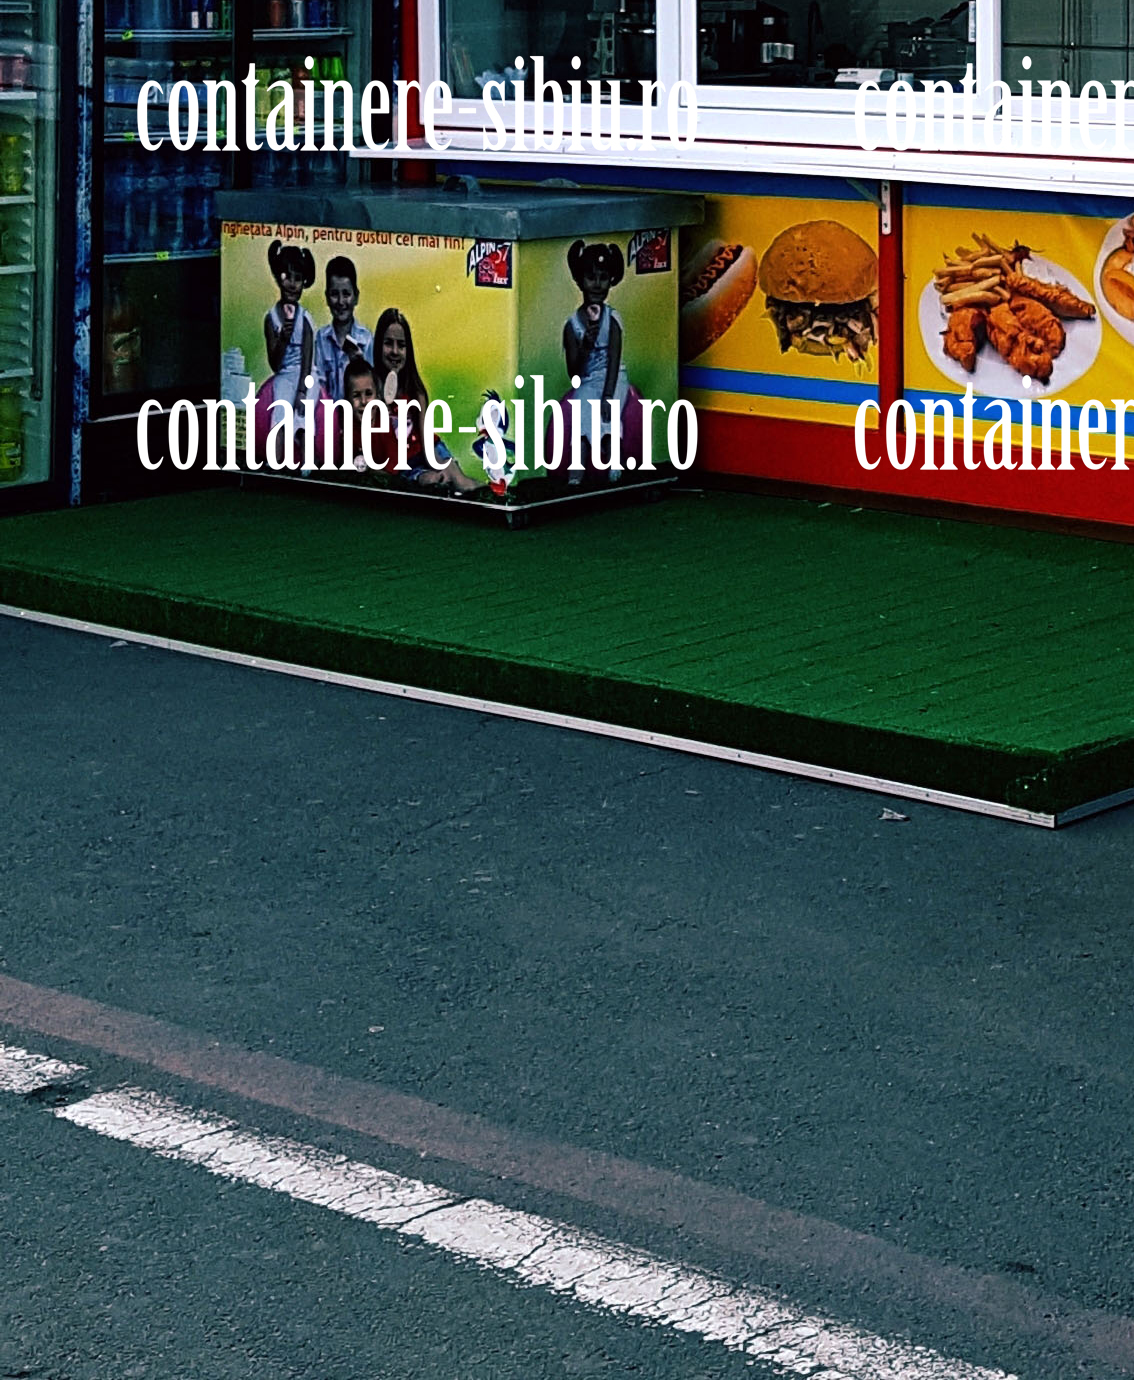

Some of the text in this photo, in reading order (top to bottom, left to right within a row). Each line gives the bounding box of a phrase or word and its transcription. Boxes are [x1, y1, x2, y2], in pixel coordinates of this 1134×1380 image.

[313, 228, 352, 243] pentru
[356, 230, 392, 246] gustul
[396, 233, 414, 247] cel
[418, 235, 440, 249] mai
[469, 241, 496, 273] ALPIN
